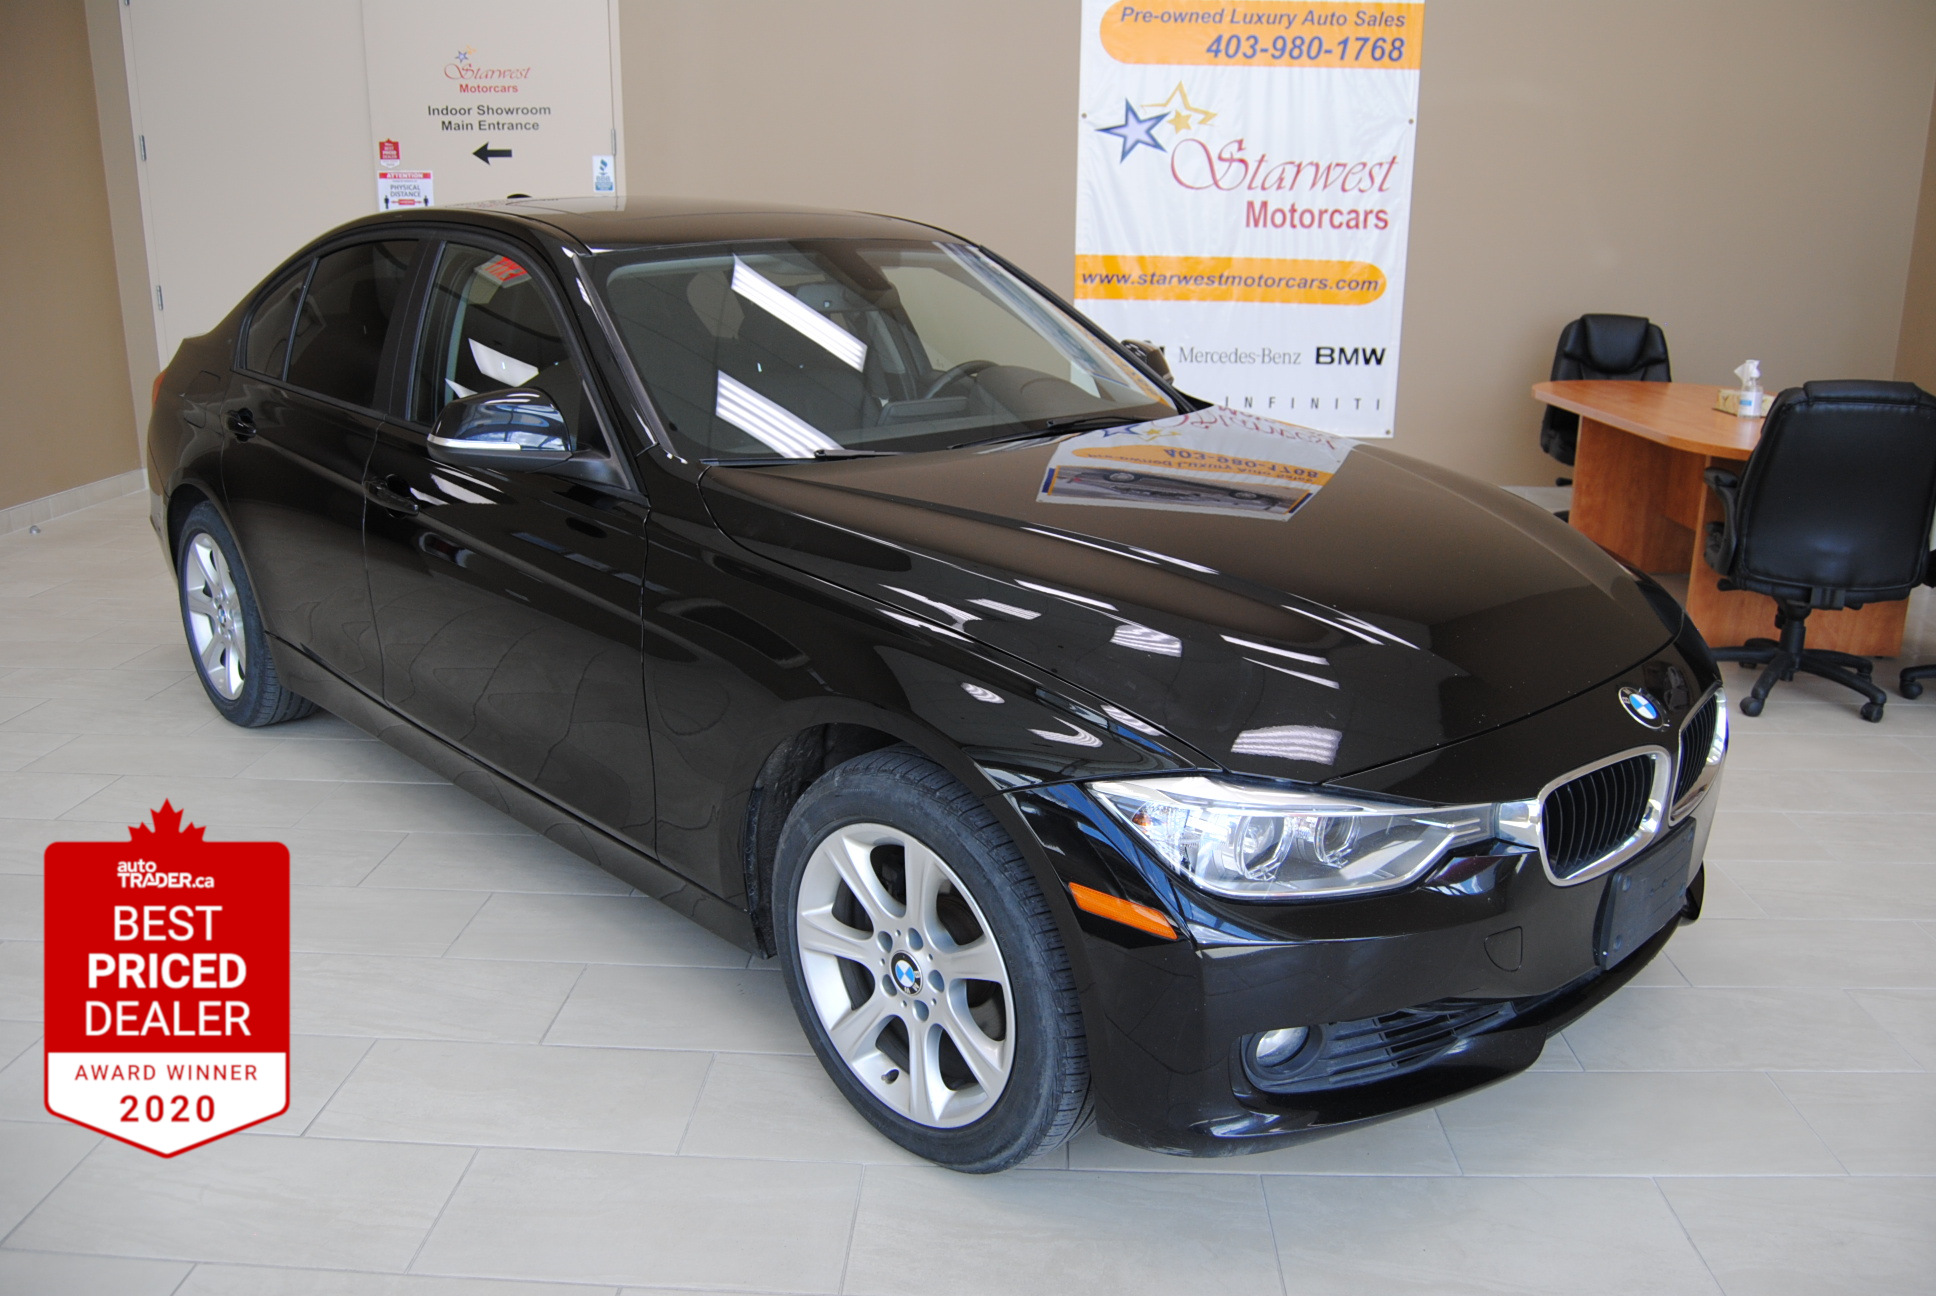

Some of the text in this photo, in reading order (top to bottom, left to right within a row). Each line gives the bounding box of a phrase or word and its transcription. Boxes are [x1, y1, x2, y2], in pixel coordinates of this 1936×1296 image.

[1120, 6, 1406, 29] Pre-owned Luxury Auto Sales
[1206, 34, 1406, 62] 403-980-1768
[443, 63, 532, 80] Starwest
[459, 84, 519, 94] Motorcars
[427, 104, 552, 116] Indoor Showroom
[441, 120, 540, 131] Main Entrance
[1170, 138, 1399, 193] Starwest
[1245, 200, 1390, 230] Motorcars
[1082, 272, 1380, 292] www.starwestmotorcars.com
[1178, 346, 1302, 366] Mercedes-Benz
[1315, 346, 1387, 366] BMW
